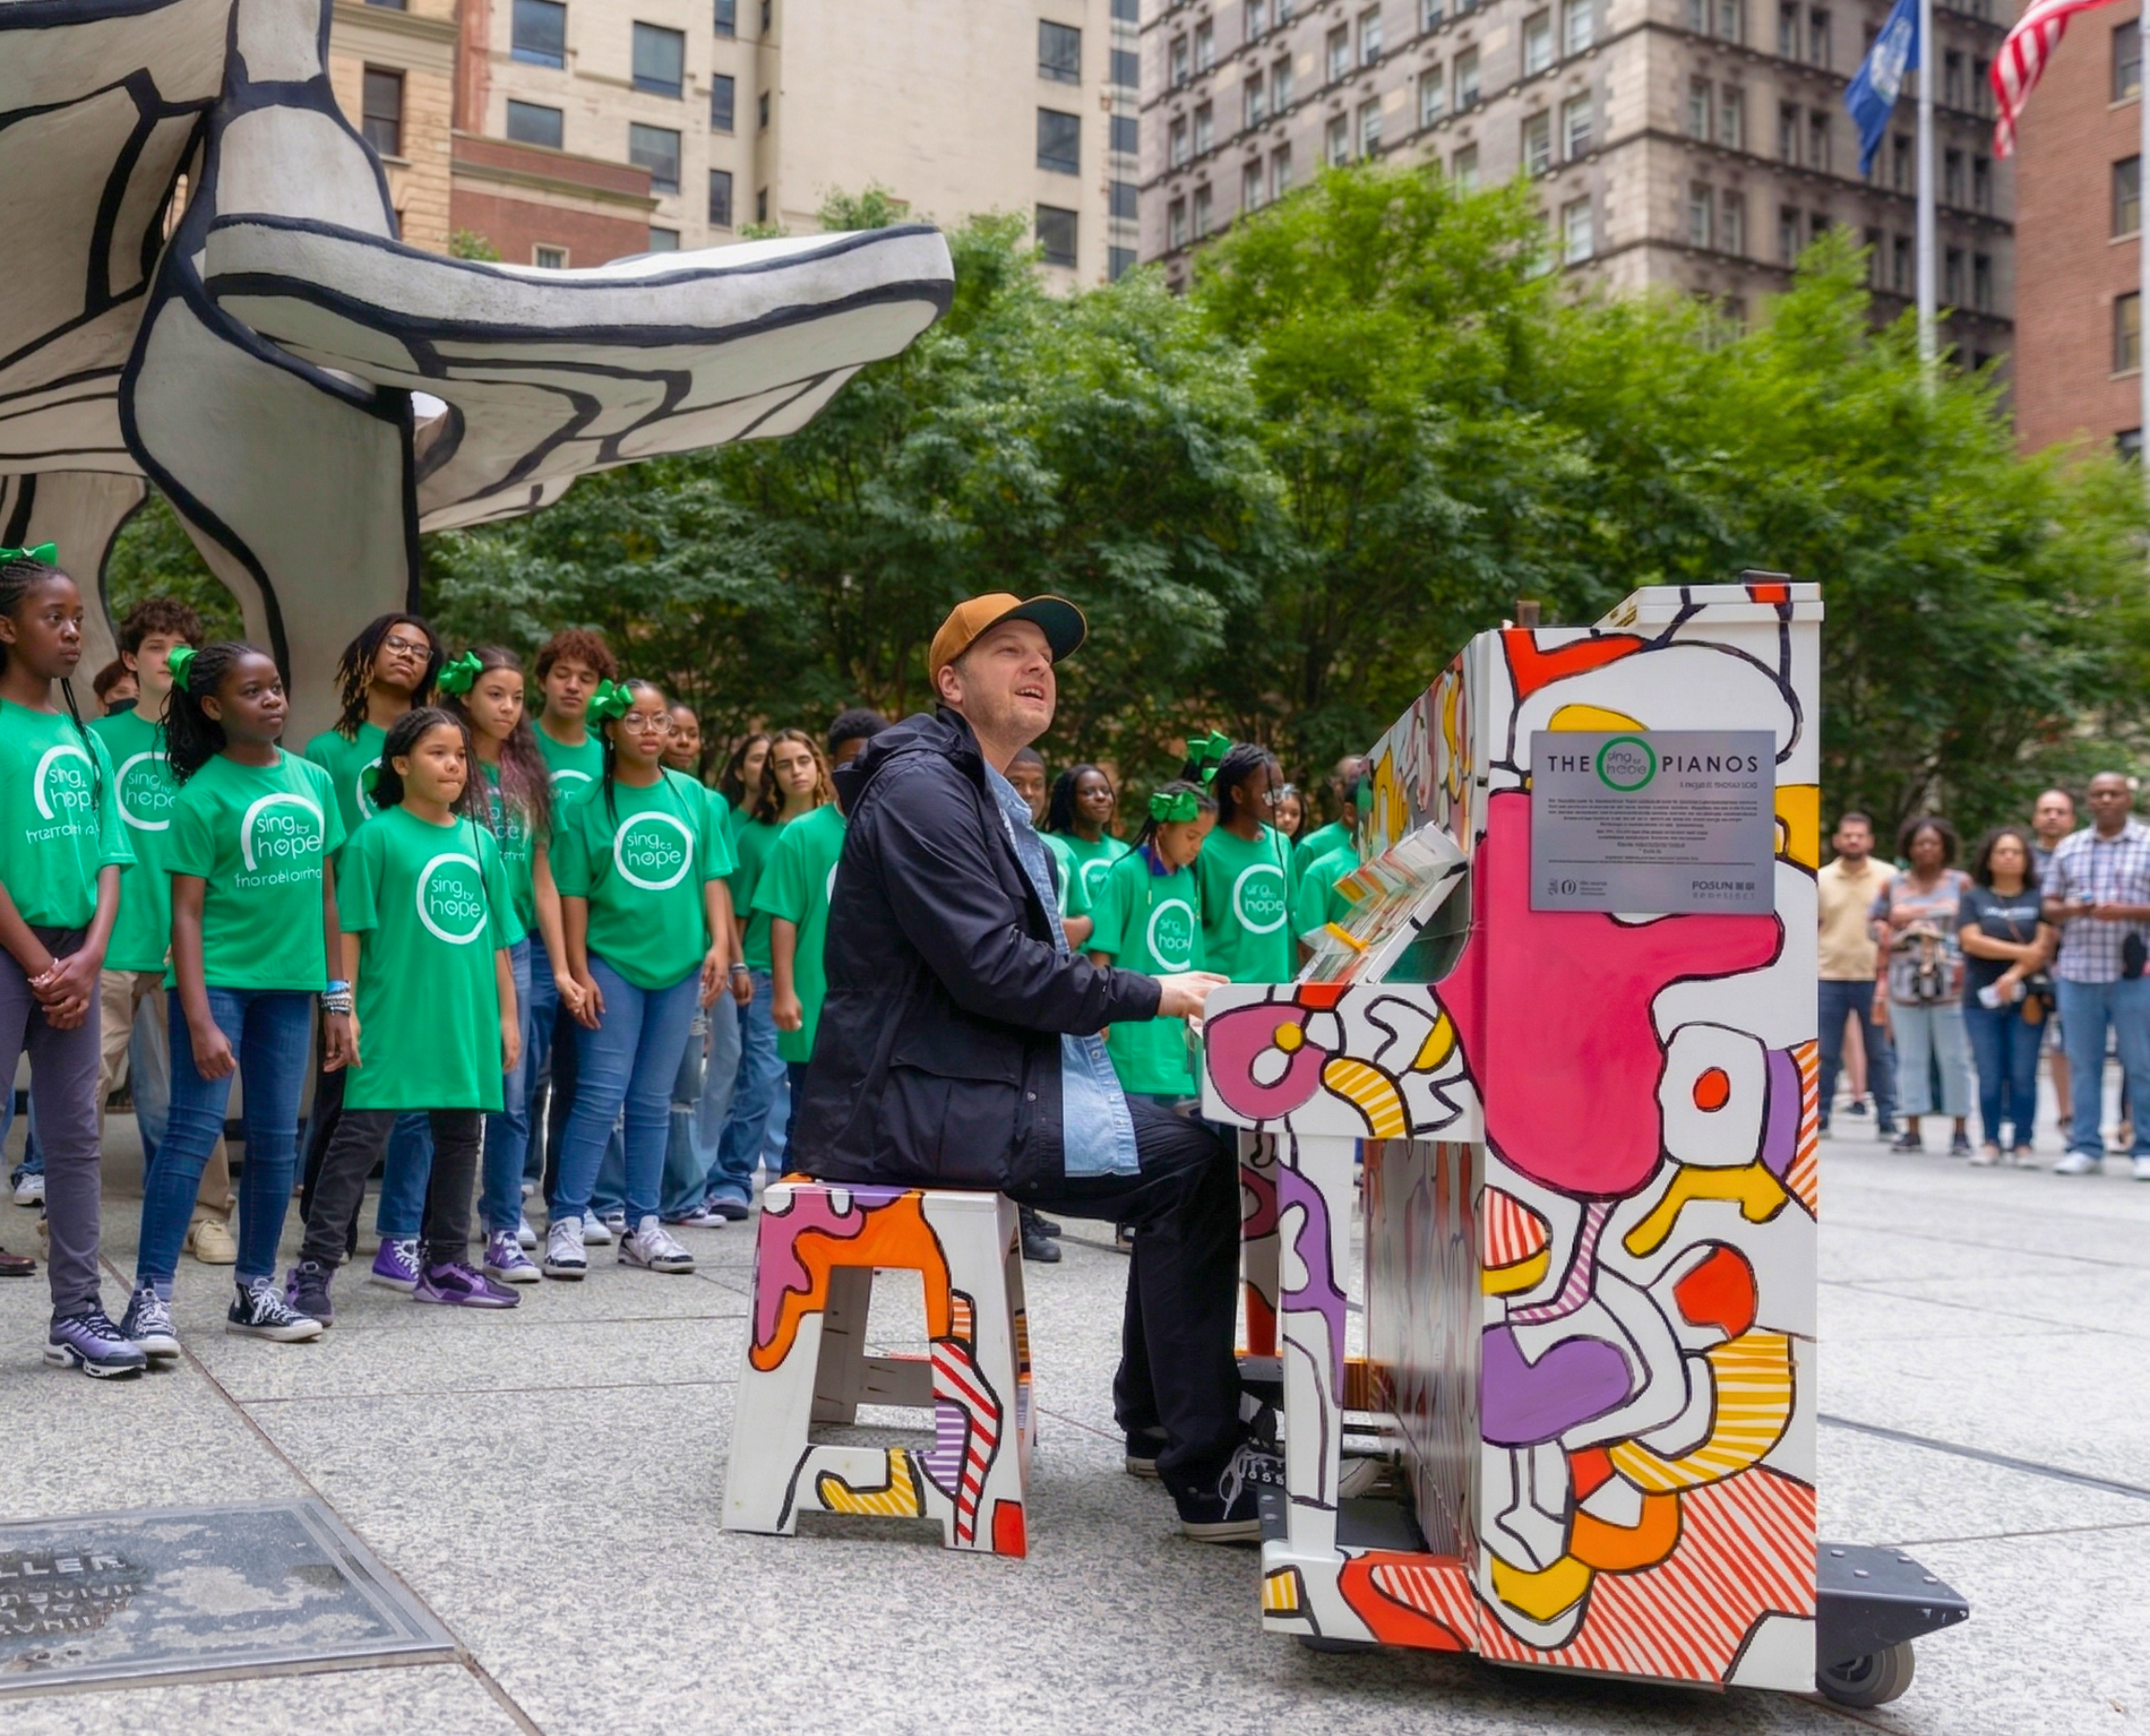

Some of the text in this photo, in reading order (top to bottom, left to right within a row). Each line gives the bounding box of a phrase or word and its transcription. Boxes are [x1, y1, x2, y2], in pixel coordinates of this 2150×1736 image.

[1547, 756, 1591, 773] THE
[1662, 756, 1758, 773] PIANOS
[128, 769, 162, 791] sing
[256, 812, 296, 836] sing
[257, 836, 322, 860] hope
[628, 831, 660, 850] sing
[627, 848, 682, 870] hope
[431, 874, 463, 899] sing
[1692, 880, 1734, 890] FOSUN
[430, 893, 482, 921] hope
[1244, 897, 1284, 916] hope
